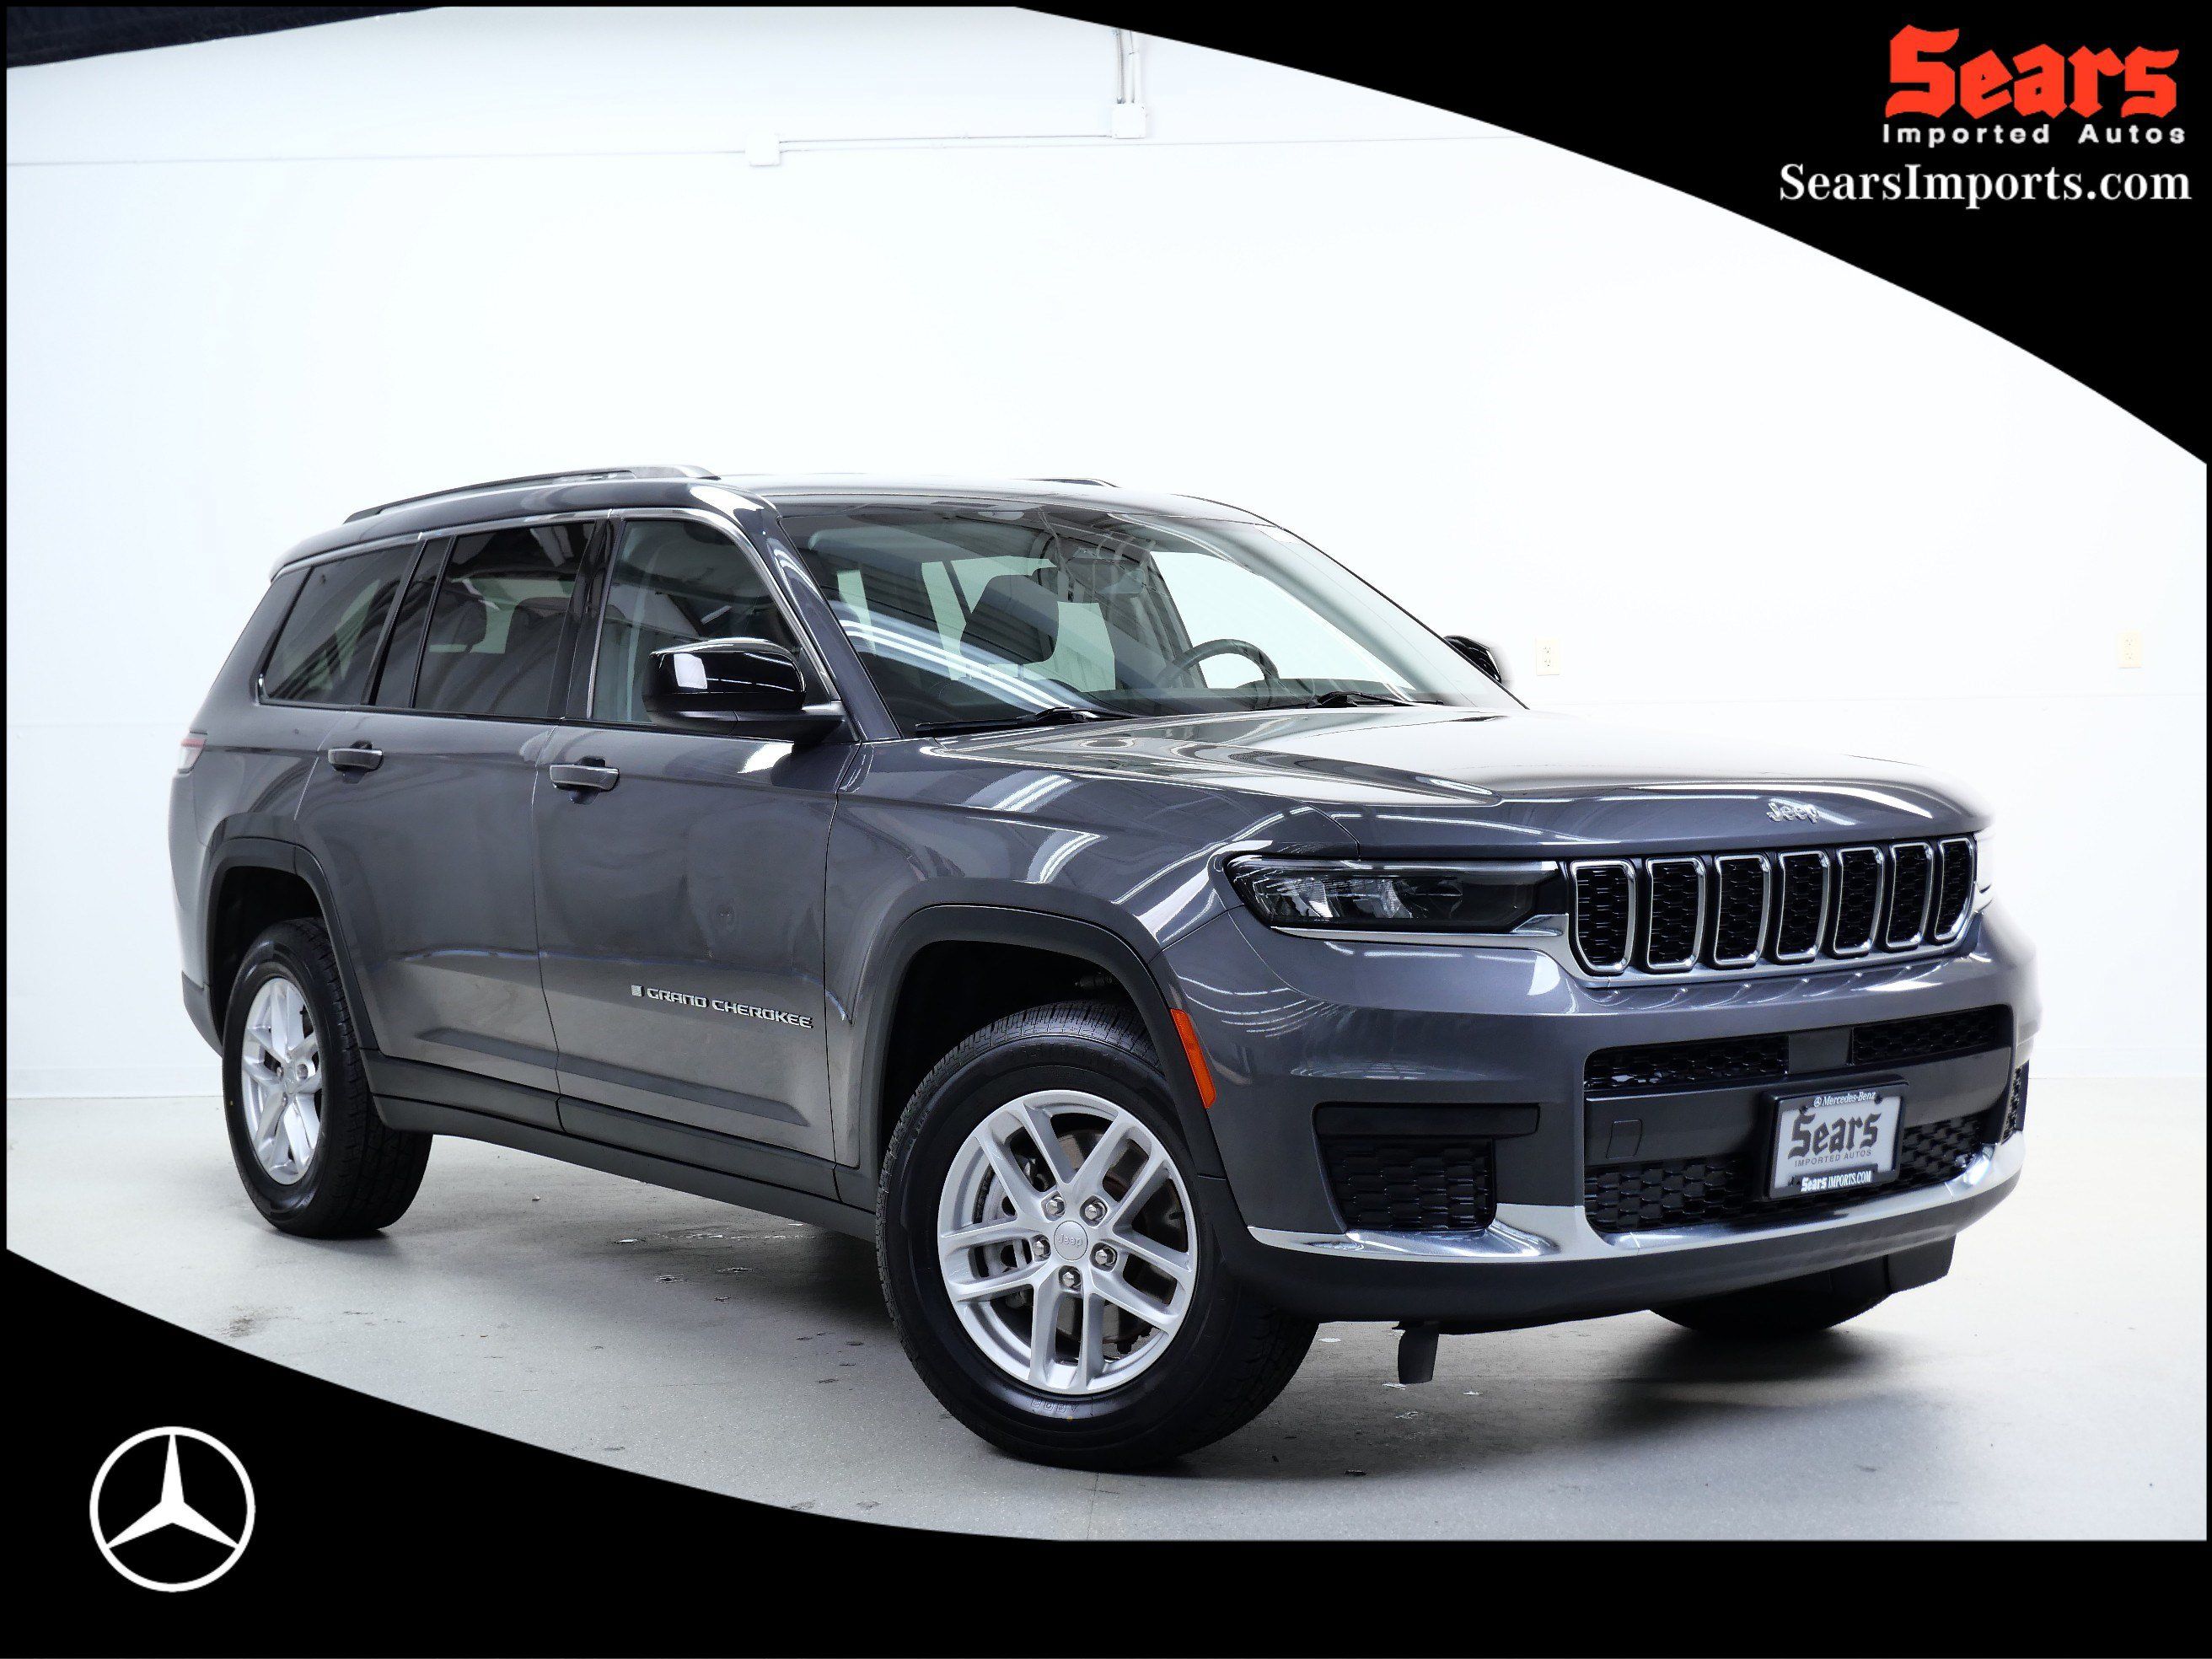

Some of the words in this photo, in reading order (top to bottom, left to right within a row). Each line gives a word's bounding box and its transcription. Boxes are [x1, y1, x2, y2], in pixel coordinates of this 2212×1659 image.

[1766, 802, 1819, 824] Jeep
[647, 987, 709, 1008] GRAND
[711, 1000, 813, 1028] CHEROKEE
[1822, 1091, 1876, 1107] Mercedes-Benz
[1787, 1112, 1882, 1160] Sears
[1794, 1154, 1841, 1168] IMPORTED
[1844, 1149, 1871, 1160] AUTOS
